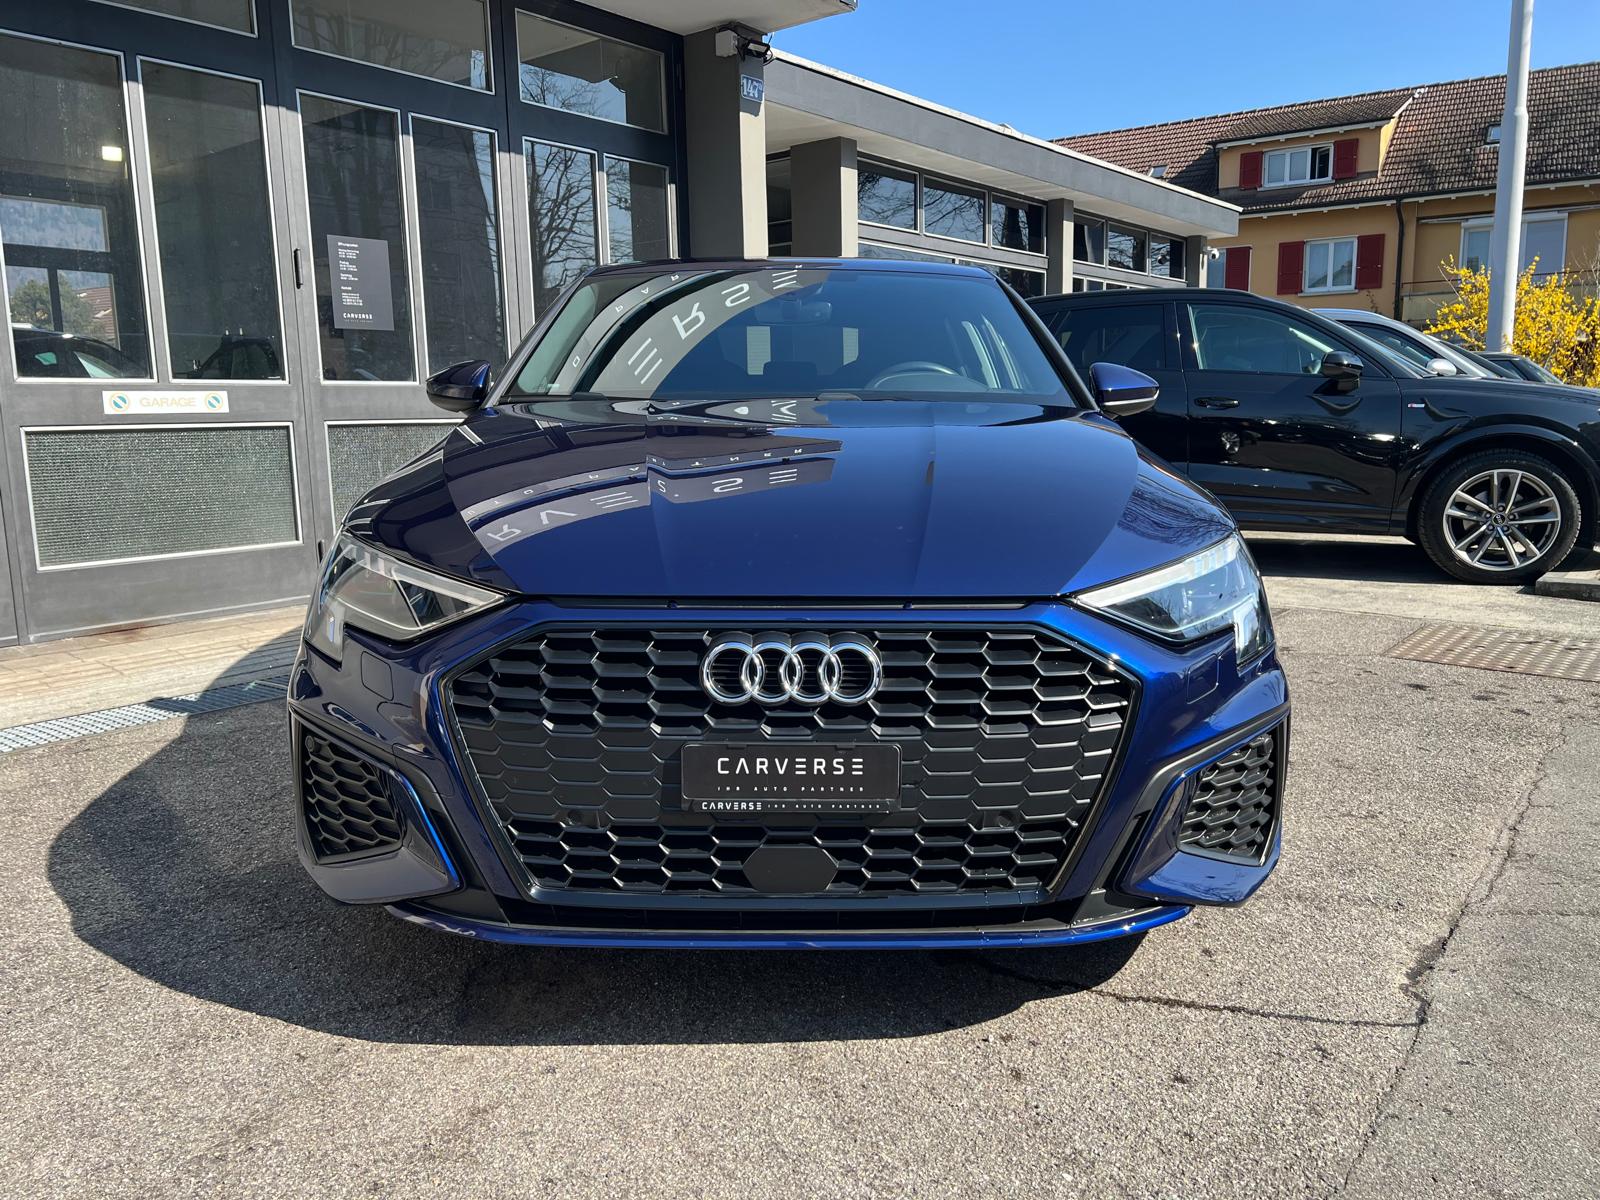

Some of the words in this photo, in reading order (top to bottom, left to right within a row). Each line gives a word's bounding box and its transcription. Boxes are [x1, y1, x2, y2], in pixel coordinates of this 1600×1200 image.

[343, 312, 373, 320] CARVERSE
[139, 397, 196, 408] GARAGE
[717, 757, 864, 775] CARVERSE
[701, 801, 762, 810] CARVERSE
